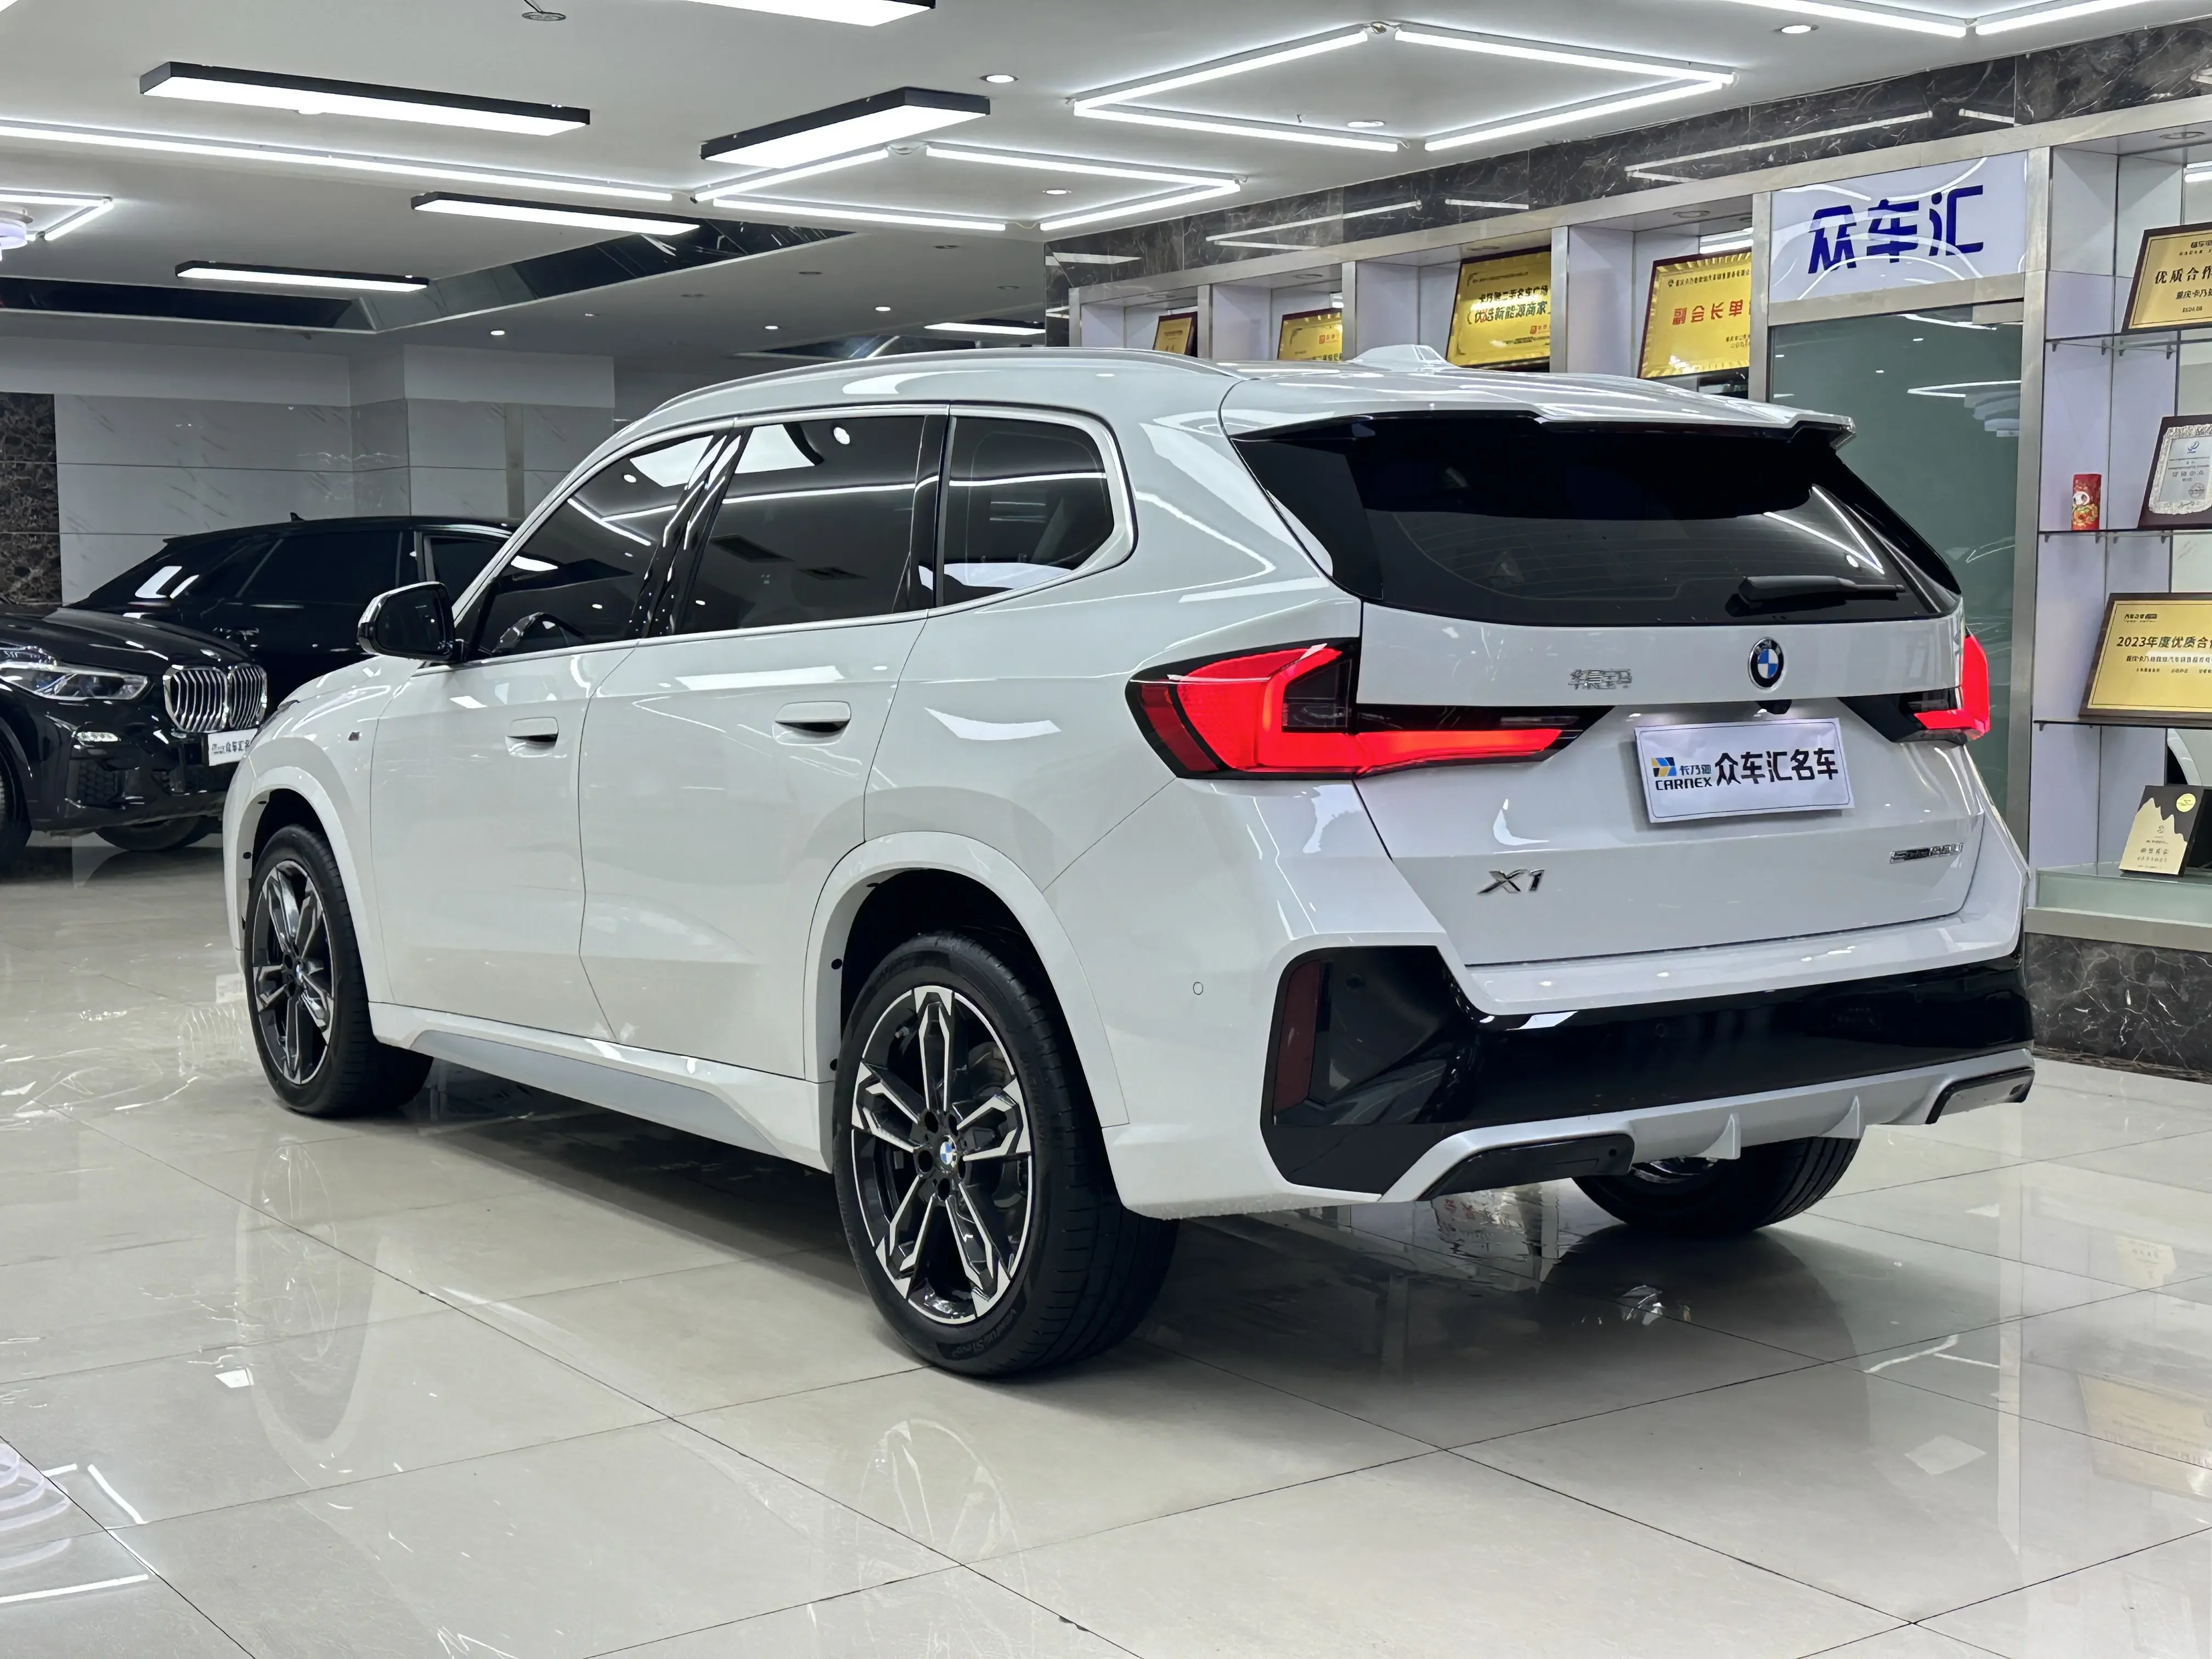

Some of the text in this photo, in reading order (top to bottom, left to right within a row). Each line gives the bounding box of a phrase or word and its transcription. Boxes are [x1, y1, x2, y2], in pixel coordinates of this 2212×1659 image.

[1808, 185, 1984, 274] 众车汇
[1672, 299, 1751, 325] 副会长单
[2117, 636, 2212, 648] 2023年度优质合
[1714, 747, 1838, 786] 众车汇名车
[1476, 868, 1545, 895] X1
